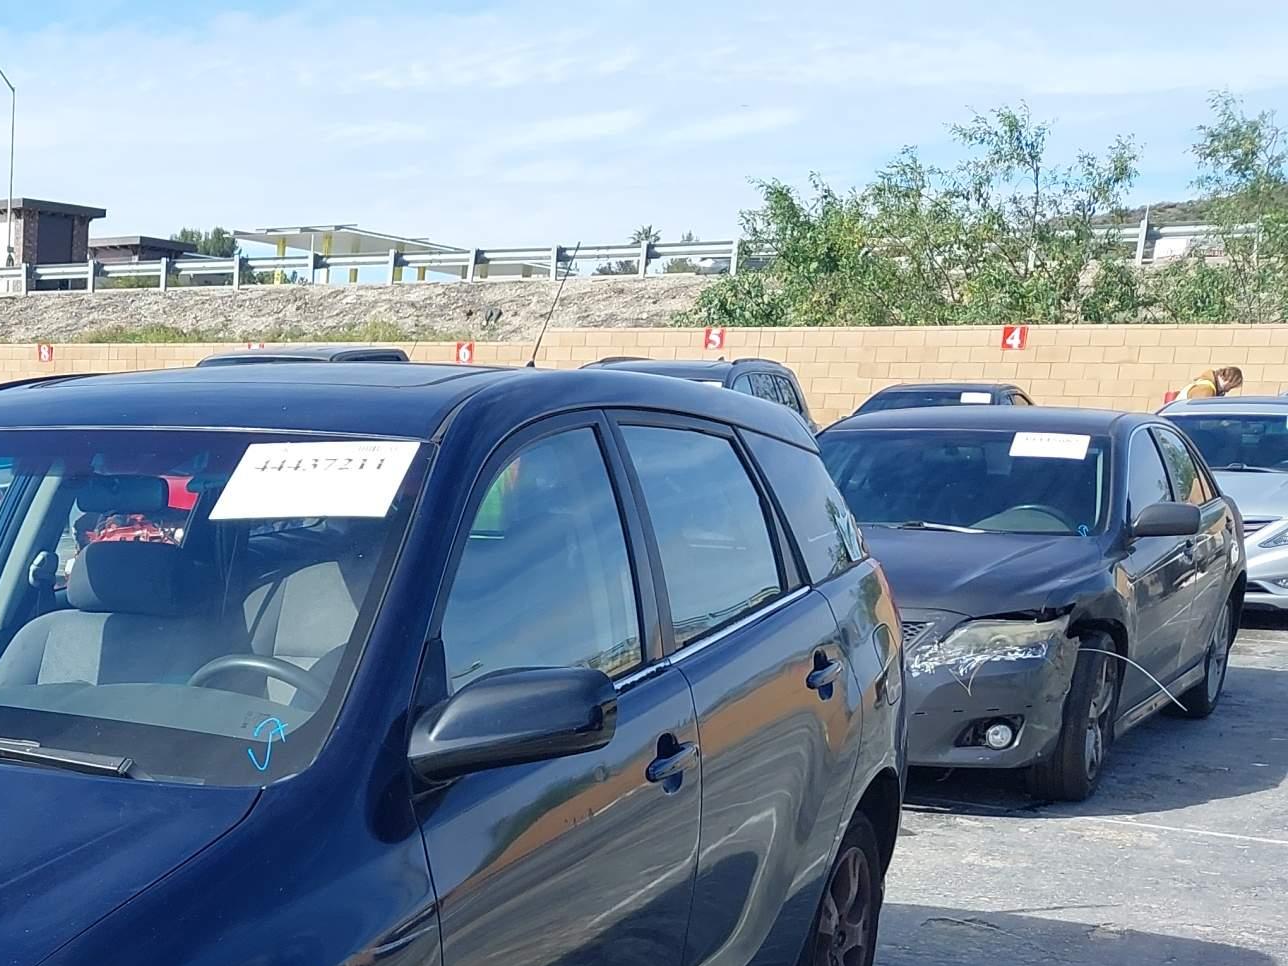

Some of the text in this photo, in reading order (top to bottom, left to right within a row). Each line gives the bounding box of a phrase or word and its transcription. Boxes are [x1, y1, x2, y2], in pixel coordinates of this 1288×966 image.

[708, 327, 721, 350] 5
[1005, 326, 1022, 350] 4
[40, 344, 50, 361] 8
[458, 342, 472, 363] 6
[255, 457, 387, 472] 44437211
